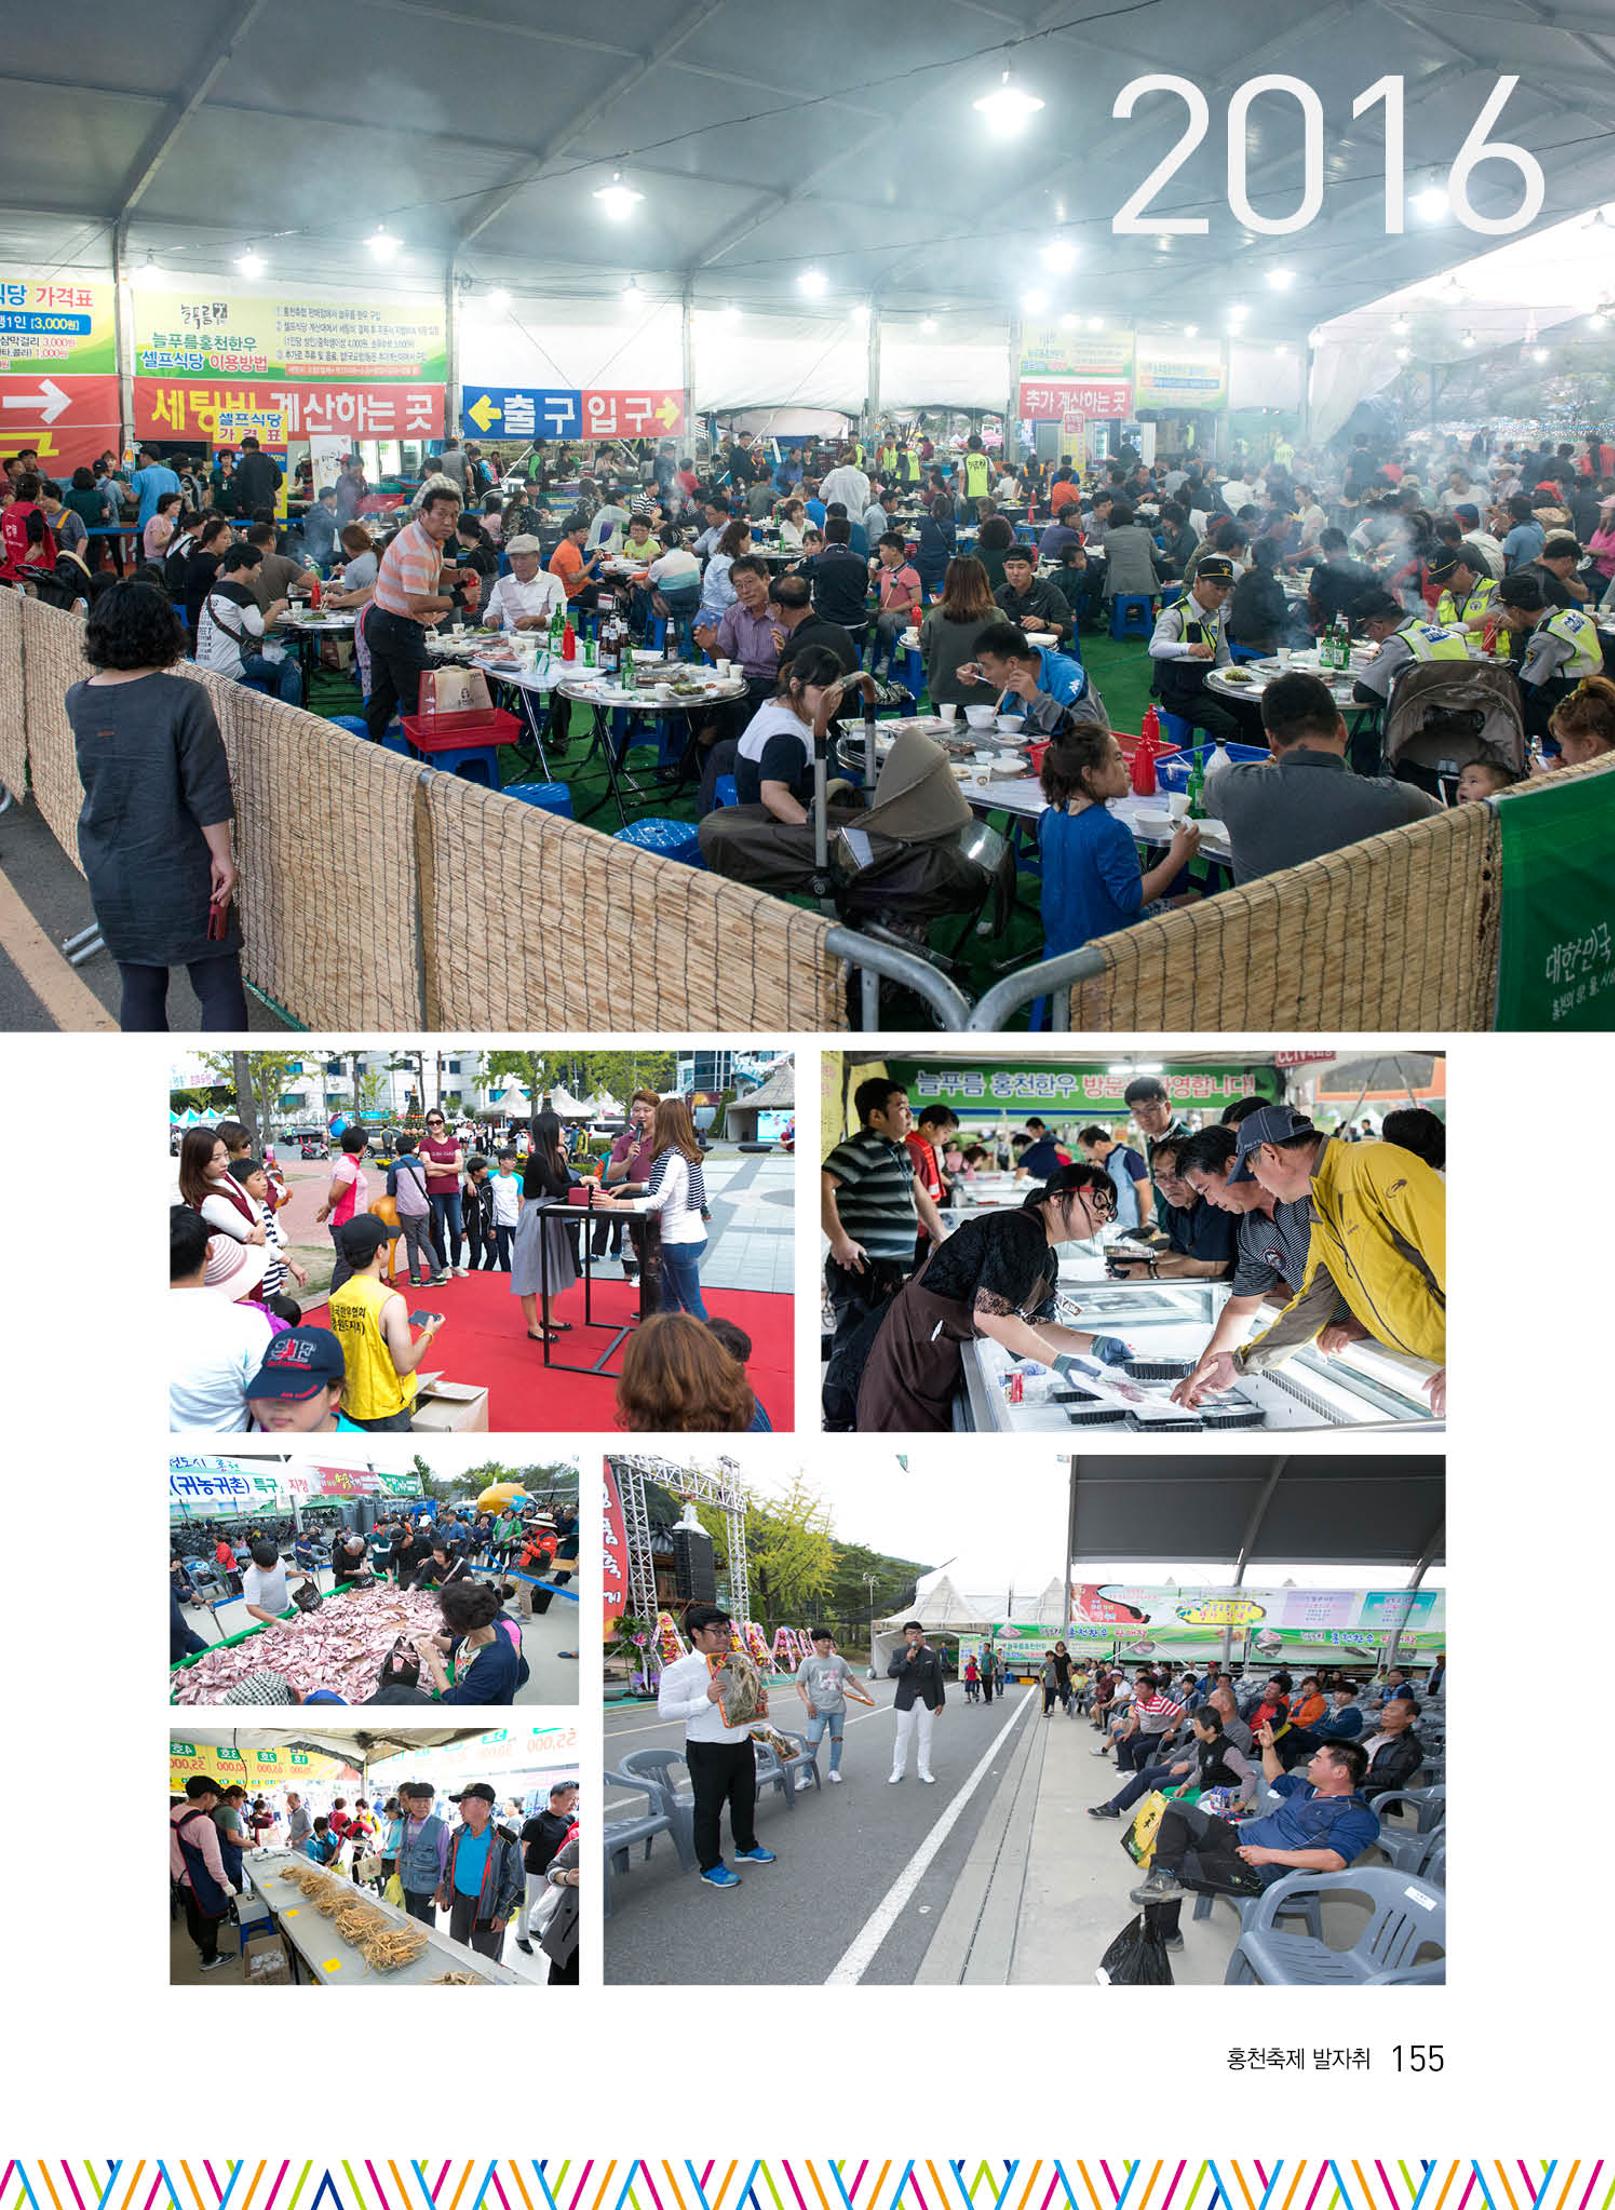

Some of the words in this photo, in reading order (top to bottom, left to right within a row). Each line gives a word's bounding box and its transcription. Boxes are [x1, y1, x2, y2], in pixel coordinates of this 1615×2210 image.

[36, 287, 93, 307] 가격표
[153, 332, 256, 351] 늘푸름홍천한우
[142, 351, 203, 370] 셀프식당
[210, 354, 268, 372] 이용방법
[270, 391, 395, 432] 계산하는
[406, 394, 434, 431] 곳
[1026, 390, 1054, 412] 추가
[1058, 391, 1111, 413] 계산하는
[1113, 391, 1126, 412] 곳
[219, 412, 282, 428] 셀프식당
[503, 394, 576, 435] 출구
[588, 396, 653, 433] 입구
[1546, 921, 1611, 984] 대한민국
[916, 1070, 987, 1097] 늘푸름
[991, 1072, 1078, 1098] 홍천한우
[1083, 1074, 1129, 1098] 방문
[1165, 1074, 1256, 1098] 영합니다!
[170, 1474, 250, 1496] (귀농귀촌)
[254, 1477, 279, 1494] 특구
